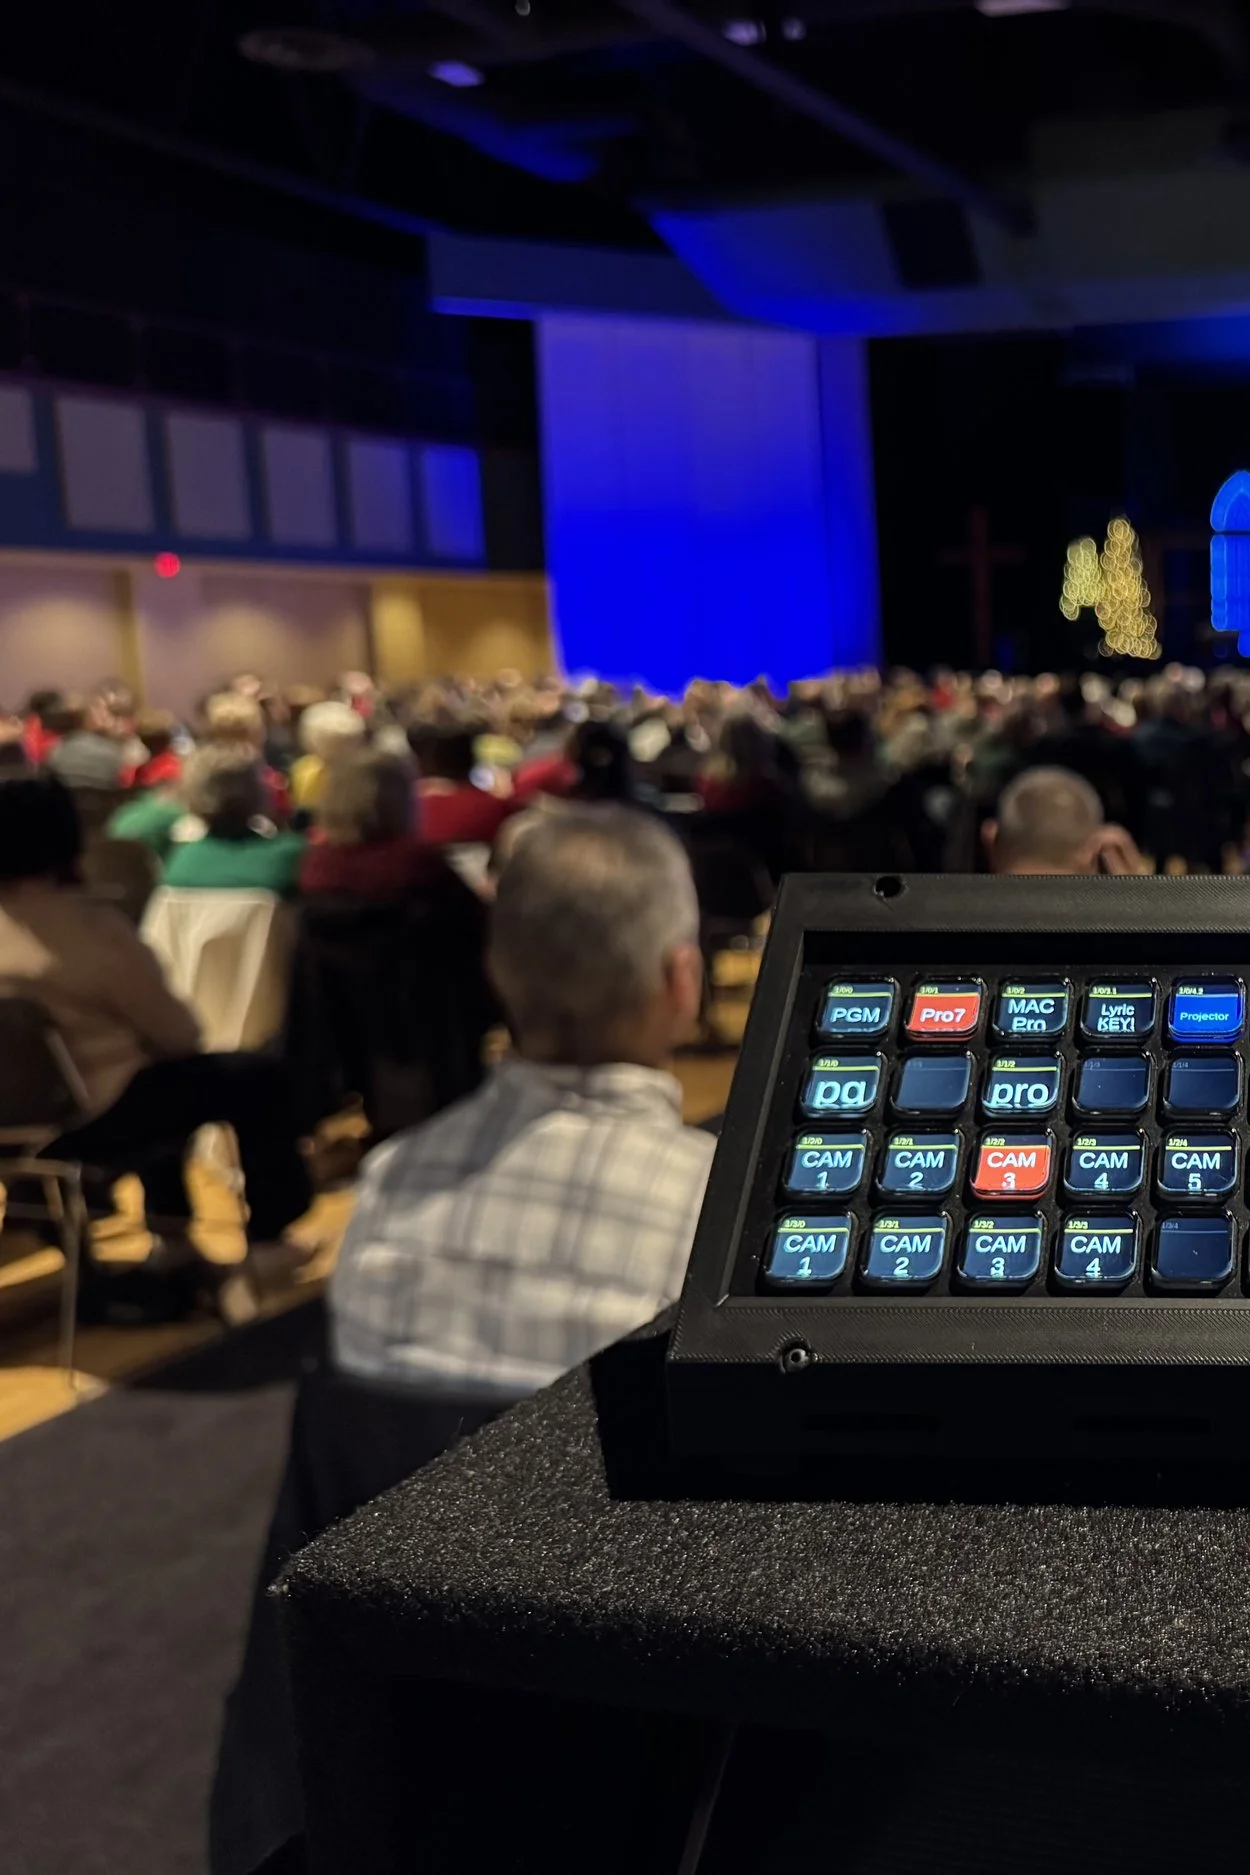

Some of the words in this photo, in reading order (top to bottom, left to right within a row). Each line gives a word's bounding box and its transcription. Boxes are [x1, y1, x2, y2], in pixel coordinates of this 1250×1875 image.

[1008, 999, 1055, 1014] MAC
[1101, 1003, 1135, 1017] Lyric
[831, 1007, 880, 1023] PGM
[920, 1008, 967, 1023] Pro7
[1180, 1012, 1230, 1023] Projector
[1012, 1017, 1047, 1031] Pro
[996, 1060, 1016, 1068] 1/1/2
[991, 1083, 1049, 1107] pro
[1077, 1138, 1097, 1146] 1/2/3
[801, 1151, 853, 1168] CAM
[895, 1151, 945, 1168] CAM
[987, 1152, 1037, 1168] CAM
[1079, 1152, 1129, 1169] CAM
[1171, 1152, 1220, 1170] CAM
[816, 1171, 829, 1188] 1
[907, 1172, 924, 1188] 2
[1002, 1172, 1016, 1188] 3
[1094, 1172, 1109, 1188] 4
[1188, 1173, 1202, 1189] 5
[974, 1221, 995, 1229] 1/3/2
[1068, 1221, 1089, 1229] 1/3/3
[784, 1235, 837, 1253] CAM
[880, 1235, 932, 1253] CAM
[975, 1236, 1026, 1253] CAM
[1070, 1236, 1121, 1254] CAM
[797, 1257, 812, 1276] 1
[893, 1257, 910, 1276] 2
[991, 1258, 1005, 1276] 3
[1085, 1258, 1100, 1276] 4
